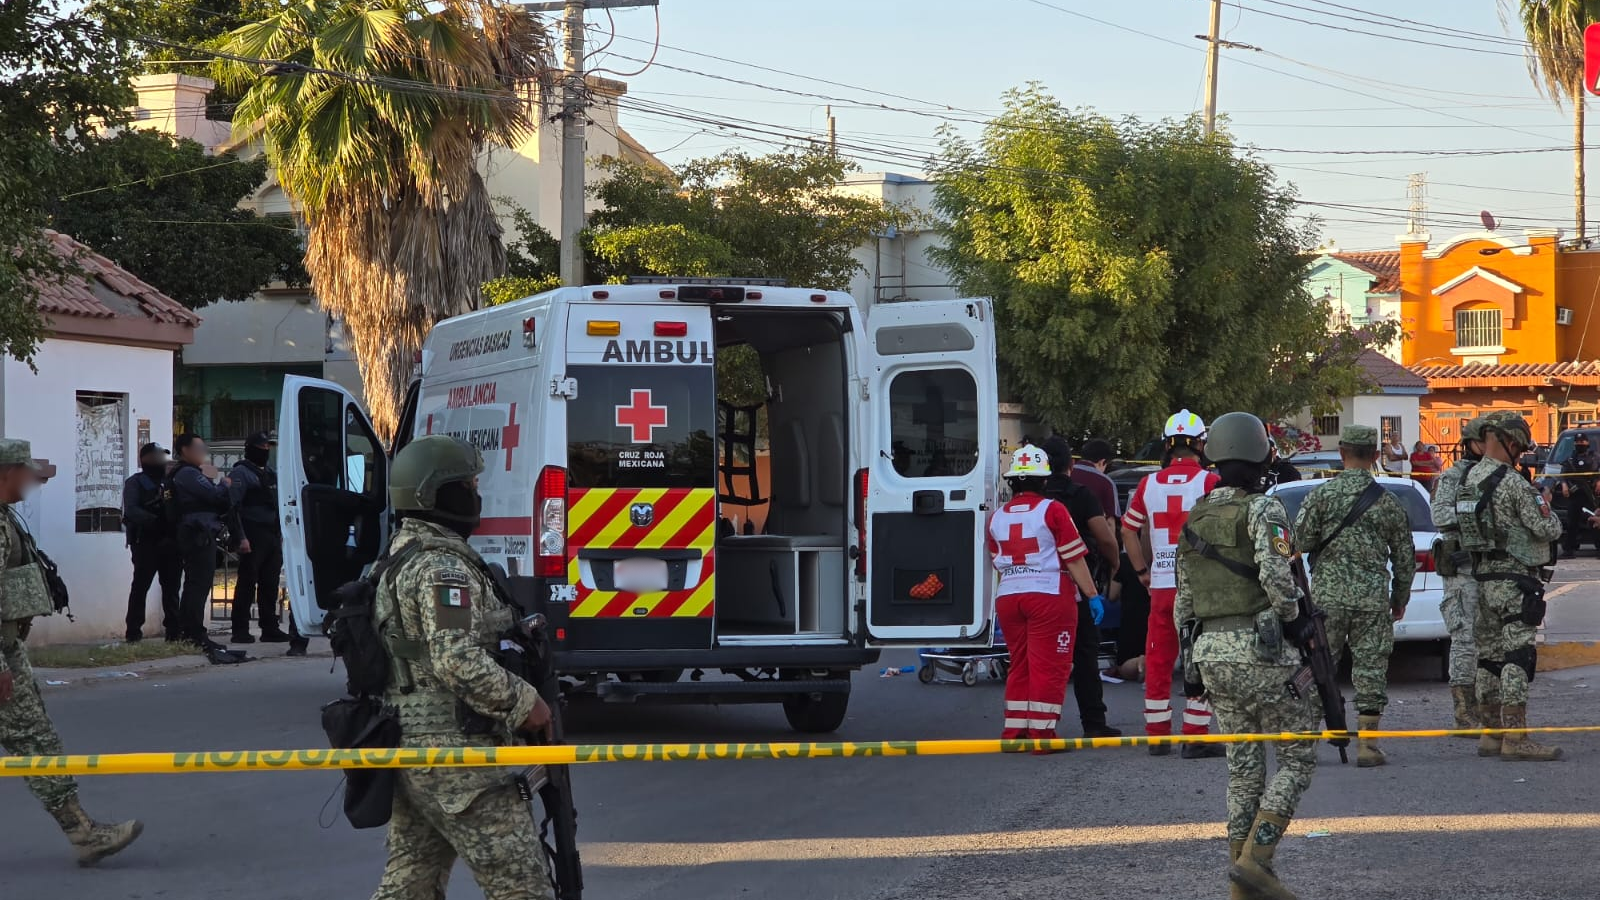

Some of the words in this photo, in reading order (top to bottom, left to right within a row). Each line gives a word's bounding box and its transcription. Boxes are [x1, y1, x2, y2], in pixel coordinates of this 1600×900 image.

[601, 339, 713, 364] AMBUL
[447, 381, 496, 408] AMBULANCIA
[618, 451, 640, 459] CRUZ
[644, 451, 665, 459] ROJA
[1034, 453, 1041, 464] 5
[618, 460, 665, 468] MEXICANA
[1156, 551, 1175, 560] CRUZ
